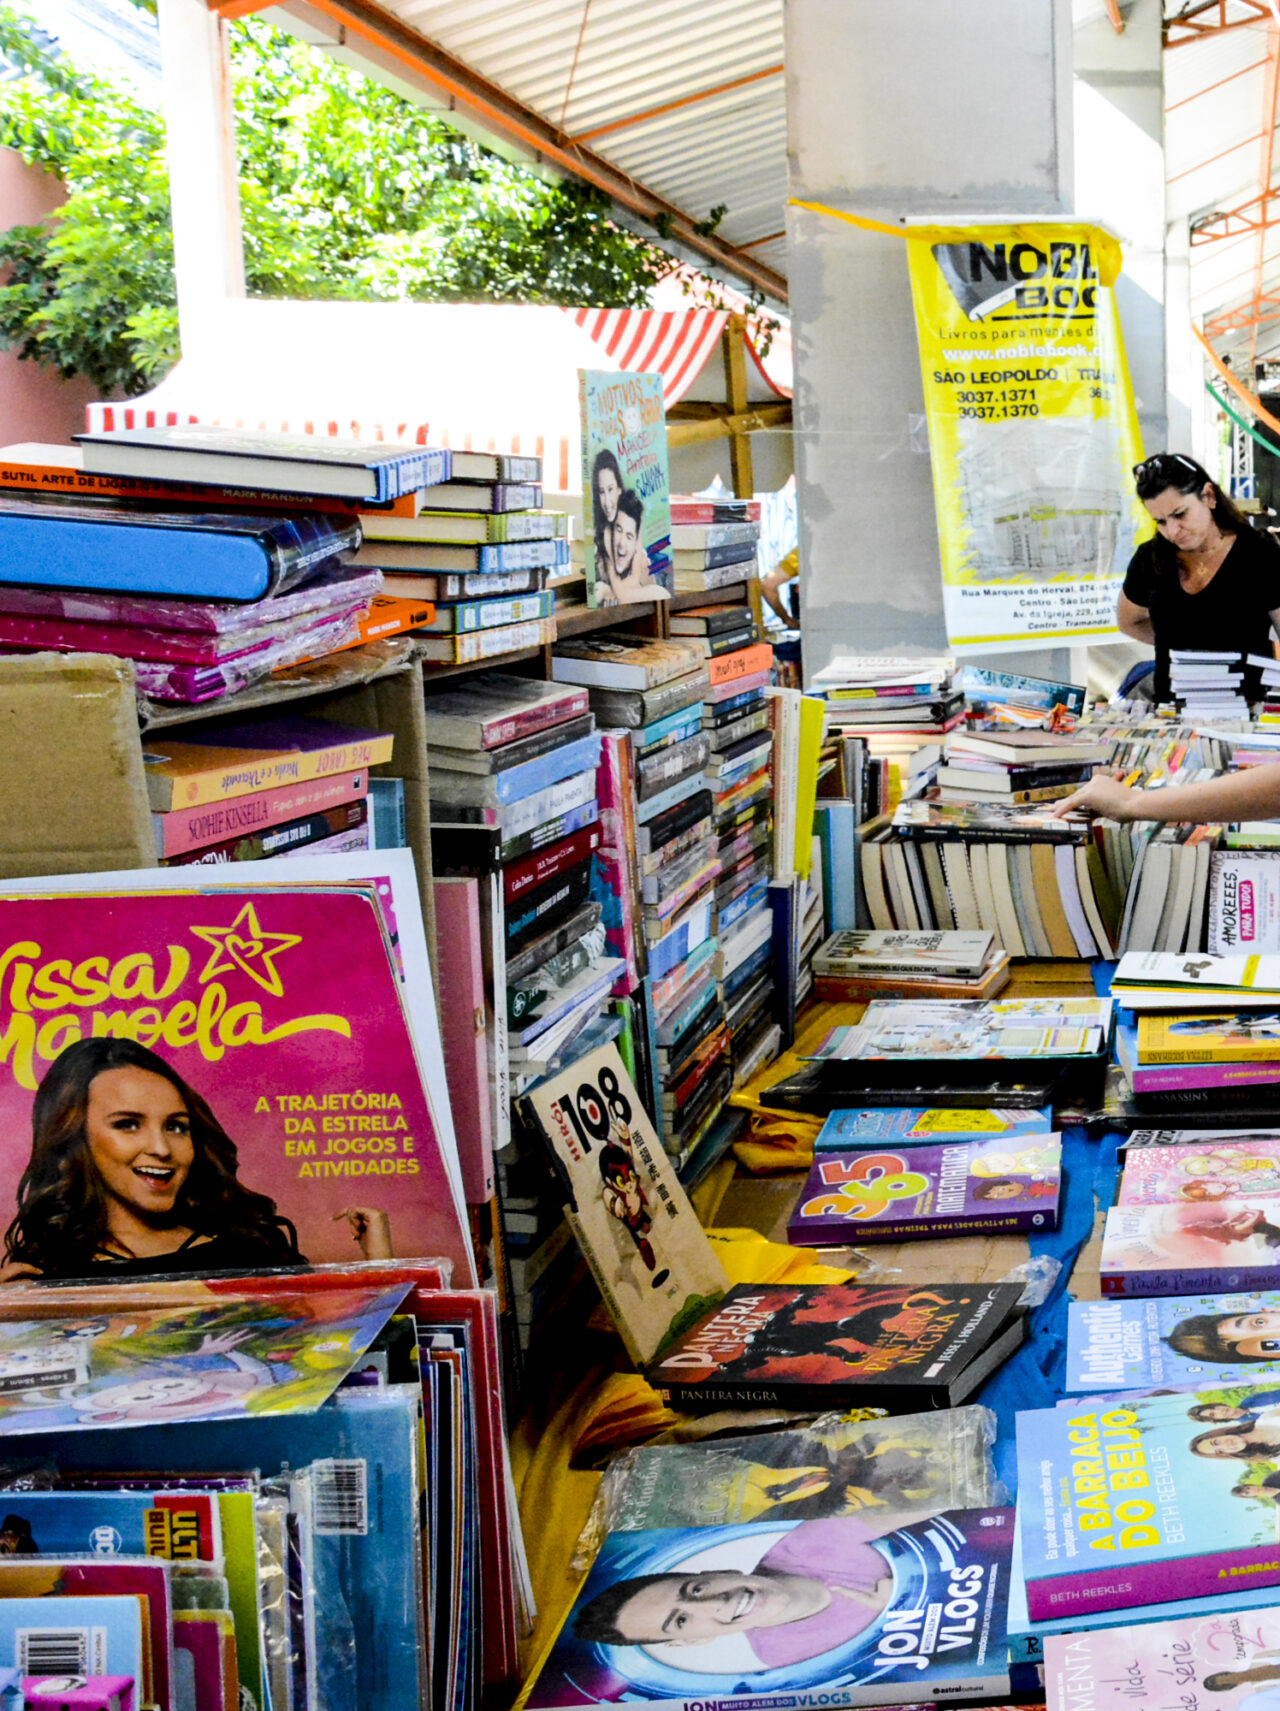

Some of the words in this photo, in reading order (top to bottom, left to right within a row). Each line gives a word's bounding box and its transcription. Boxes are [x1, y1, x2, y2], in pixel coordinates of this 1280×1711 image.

[939, 327, 987, 340] Livros
[992, 328, 1026, 341] para
[933, 367, 966, 384] SÃO
[971, 368, 1058, 384] LEOPOLDO
[956, 389, 1037, 403] 3037.1371
[957, 404, 1039, 419] 3037.1370
[1, 471, 37, 484] SUTIL
[41, 473, 74, 486] ARTE
[78, 475, 96, 488] DE
[99, 477, 139, 490] LIGAR
[223, 488, 256, 499] MARK
[260, 490, 314, 503] MANSON
[961, 589, 981, 597] Rua
[1019, 599, 1052, 607] Centro
[1028, 622, 1058, 630] Centro
[188, 814, 223, 842] SOPHIE
[222, 800, 269, 832] KINSELLA
[1240, 883, 1253, 911] TUDO!
[254, 1096, 271, 1113] A
[276, 1088, 402, 1112] TRAJETÓRIA
[556, 1066, 632, 1154] 108
[285, 1117, 316, 1135] DA
[323, 1115, 408, 1133] ESTRELA
[549, 1100, 583, 1163] HERÓI
[285, 1140, 316, 1157] EM
[322, 1137, 397, 1156] JOGOS
[402, 1136, 414, 1153] E
[299, 1158, 420, 1178] ATIVIDADES
[930, 1145, 969, 1213] MATEMÁTICA
[800, 1153, 930, 1221] 365
[659, 1295, 766, 1368] PANTERA
[715, 1310, 776, 1354] NEGRA
[960, 1299, 994, 1340] HOLLAND
[1079, 1303, 1125, 1384] Authentic
[1116, 1320, 1144, 1363] Games
[681, 1389, 734, 1401] PANTERA
[736, 1390, 778, 1402] NEGRA
[1101, 1410, 1151, 1491] BEIJO
[1037, 1459, 1054, 1477] amigo
[1067, 1412, 1114, 1532] BARRACA
[1149, 1445, 1177, 1503] REEKLES
[1039, 1477, 1055, 1498] melhor
[1044, 1497, 1055, 1509] seu
[172, 1510, 199, 1561] ULT
[1042, 1518, 1057, 1533] dizer
[1114, 1499, 1162, 1550] DO
[1162, 1505, 1186, 1545] BETH
[1043, 1532, 1061, 1549] pode
[1045, 1548, 1059, 1561] Ela
[1062, 1529, 1080, 1558] qualquer
[1089, 1533, 1117, 1551] A
[1050, 1591, 1081, 1603] BETH
[1083, 1583, 1132, 1599] REEKLES
[1218, 1569, 1228, 1578] A
[936, 1564, 985, 1653] VLOGS
[873, 1608, 930, 1671] JON
[1232, 1616, 1245, 1663] temporada
[1157, 1640, 1198, 1686] série
[1099, 1660, 1148, 1700] vida
[722, 1700, 750, 1710] MUITO
[797, 1692, 852, 1706] VLOGS
